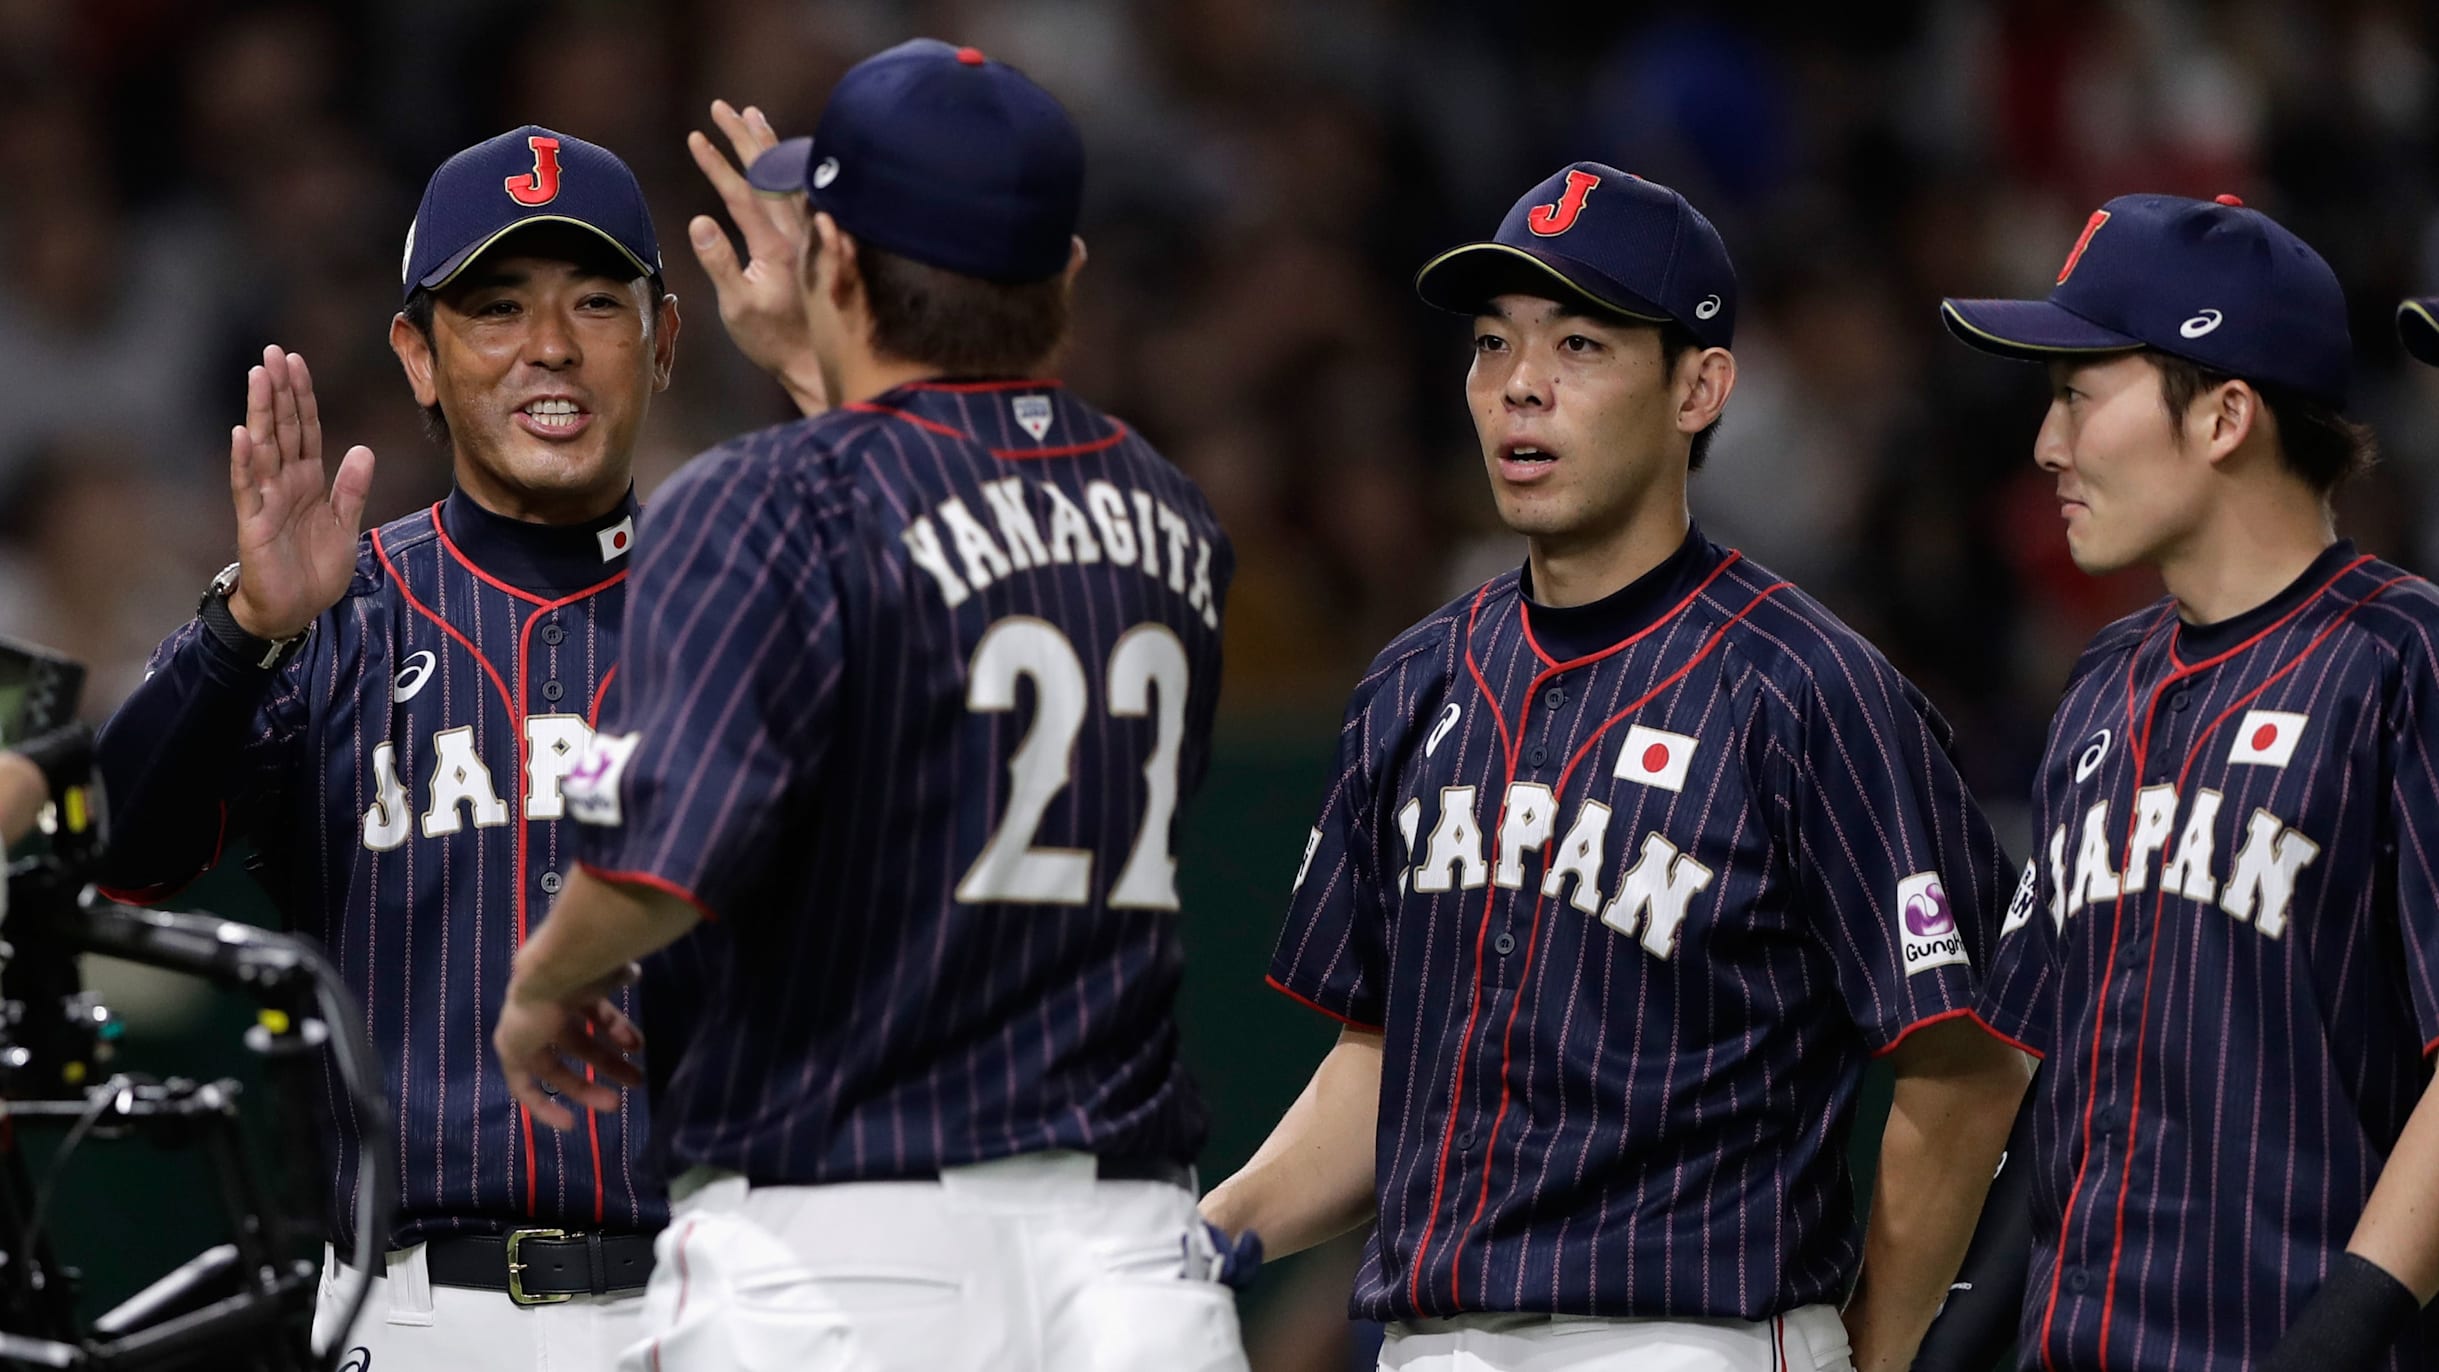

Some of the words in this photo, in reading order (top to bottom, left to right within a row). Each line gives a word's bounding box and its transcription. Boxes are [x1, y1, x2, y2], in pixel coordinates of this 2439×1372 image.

[505, 136, 563, 207] J
[1527, 169, 1601, 237] J
[901, 476, 1219, 631] YANAGITA
[363, 714, 597, 852] JAP
[955, 614, 1189, 911] 22
